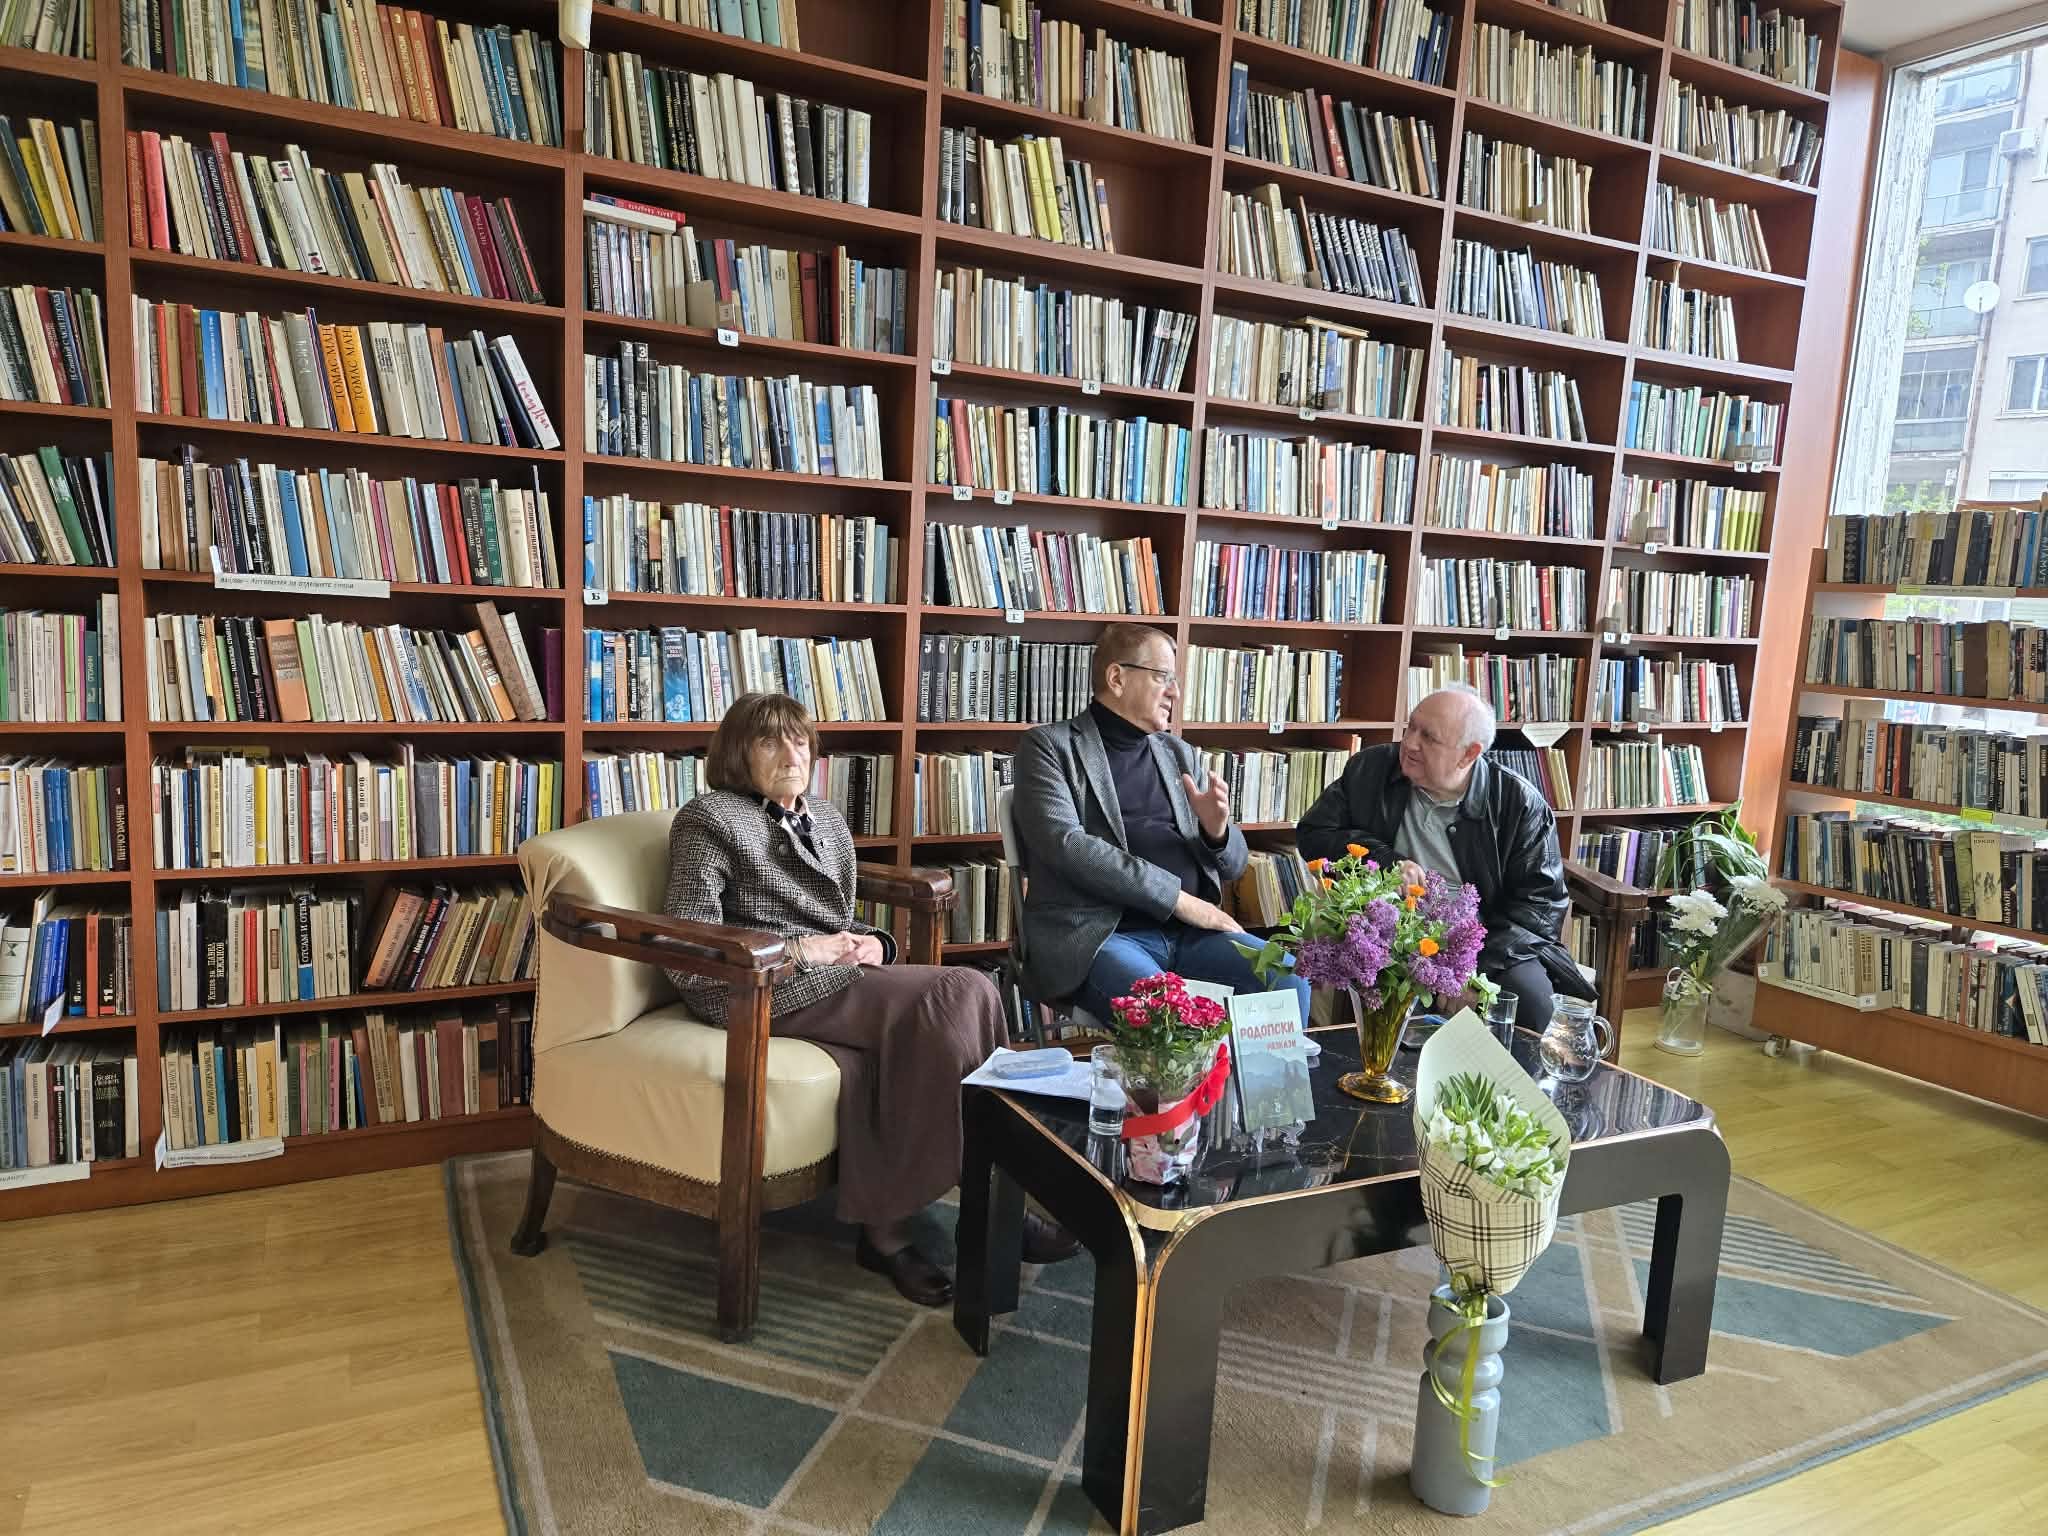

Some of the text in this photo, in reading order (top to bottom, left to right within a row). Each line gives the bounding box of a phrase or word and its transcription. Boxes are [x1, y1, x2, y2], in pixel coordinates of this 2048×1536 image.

[320, 325, 344, 400] ТОМАС МАН
[341, 327, 362, 401] ТОМАС МАН
[958, 489, 968, 498] Ж
[592, 593, 600, 601] Б
[710, 662, 721, 698] КМЕТЪТ
[115, 804, 125, 860] ПЕНЧО ДАНЧЕВ
[207, 942, 215, 965] ПАВЕЛ
[300, 933, 308, 962] ОТСАМ
[1240, 1021, 1294, 1040] РОДОПСКИ
